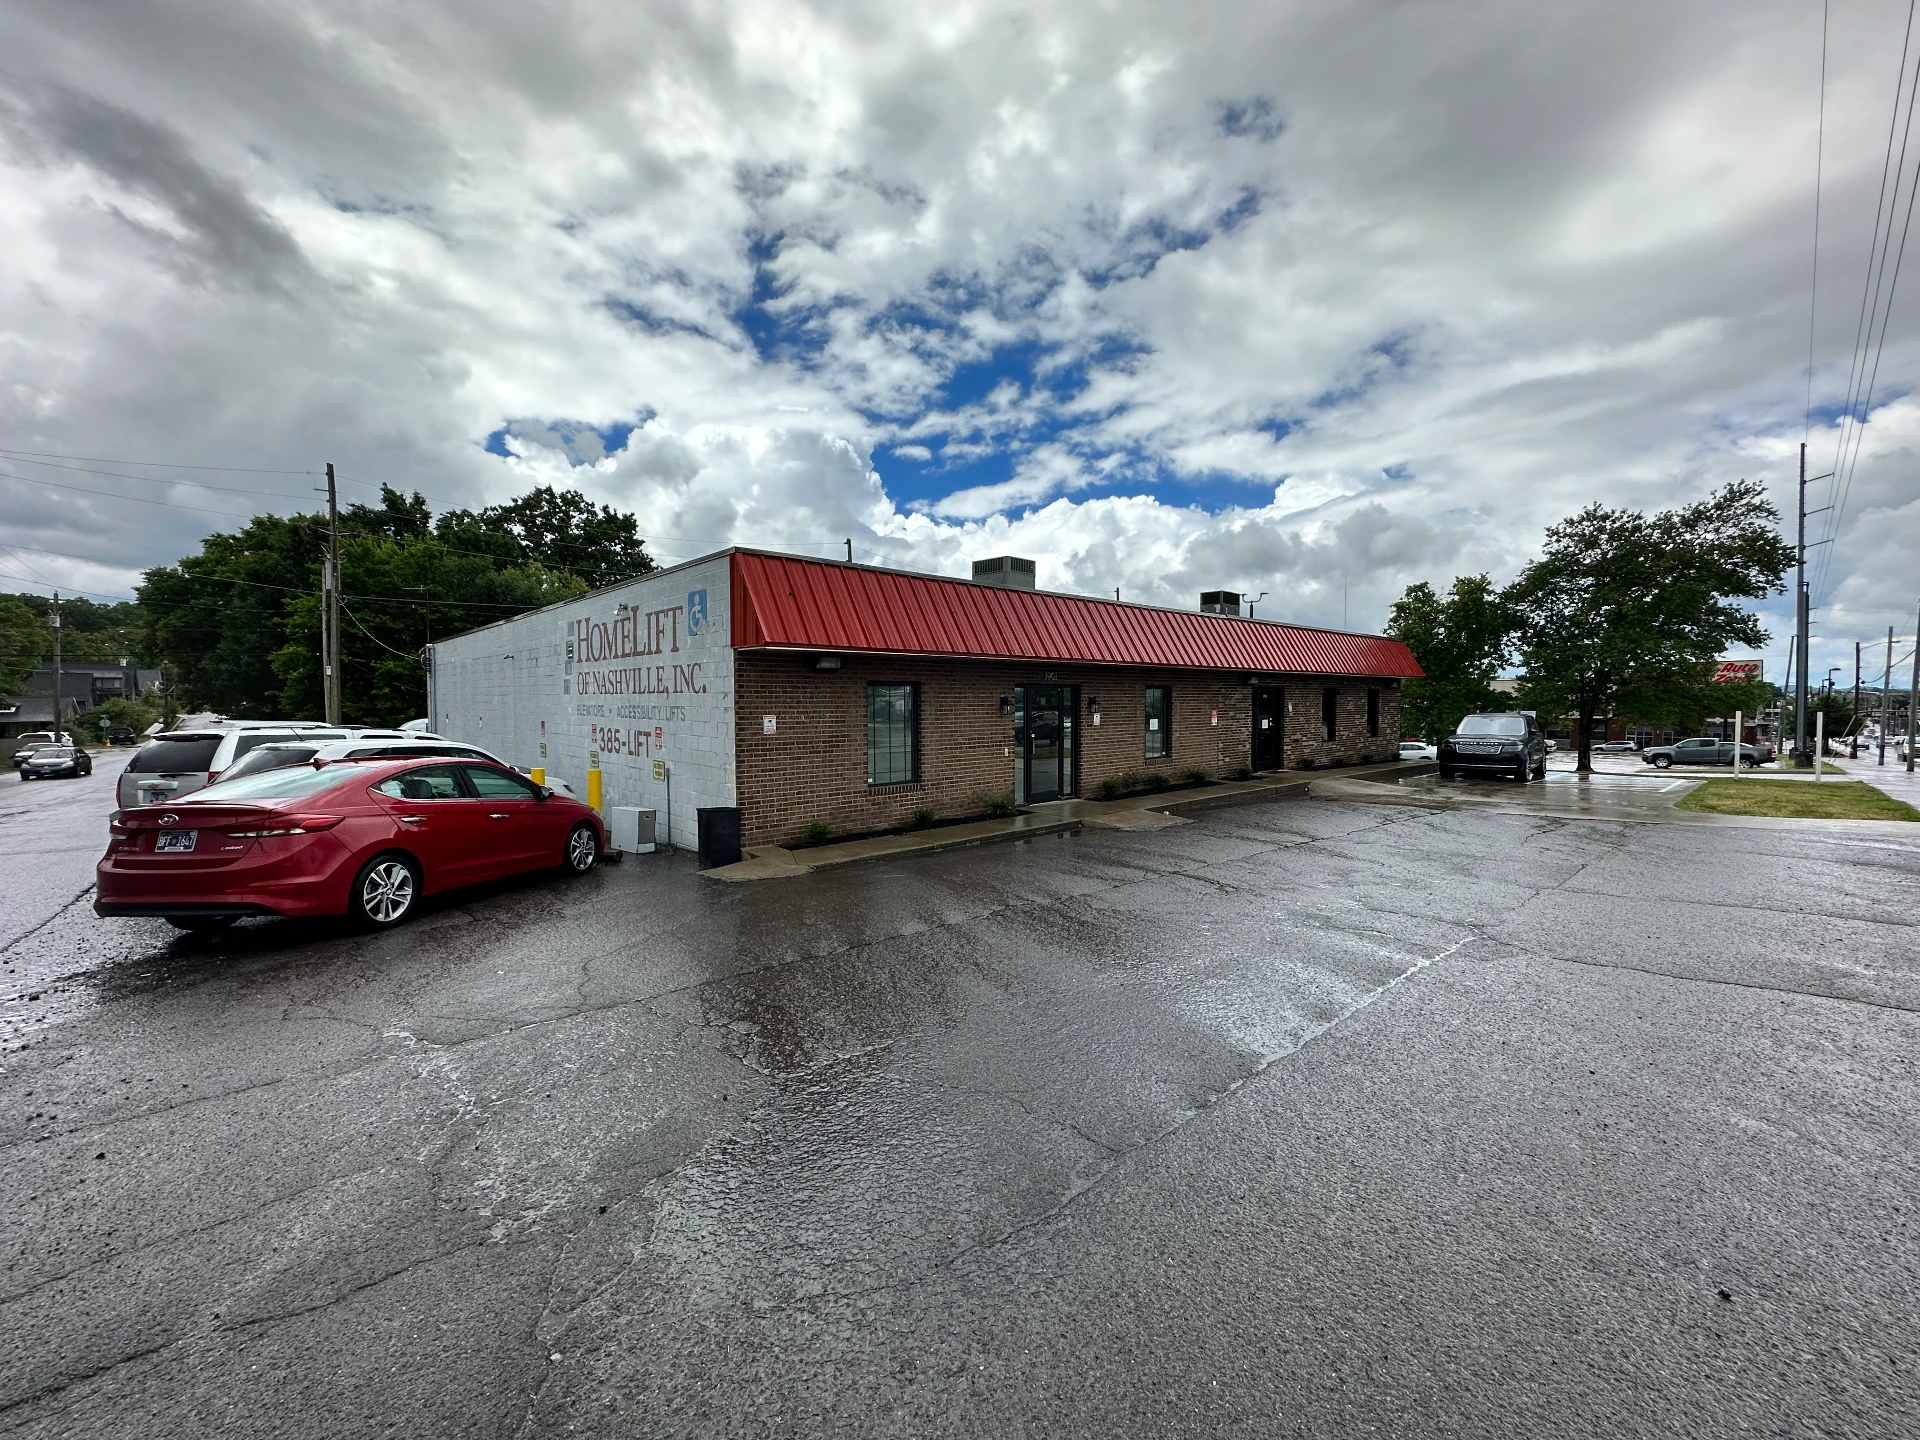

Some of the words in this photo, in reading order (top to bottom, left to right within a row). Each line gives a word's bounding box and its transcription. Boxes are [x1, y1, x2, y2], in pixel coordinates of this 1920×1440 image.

[1721, 662, 1760, 673] Auto
[577, 672, 591, 695] OF
[593, 665, 670, 699] NASHVILLE,
[673, 663, 707, 694] INC.
[576, 704, 605, 718] ELEVATORS
[616, 705, 663, 721] ACCESSIBILITY
[665, 706, 686, 722] LIFTS
[599, 727, 651, 758] 385-LIFT
